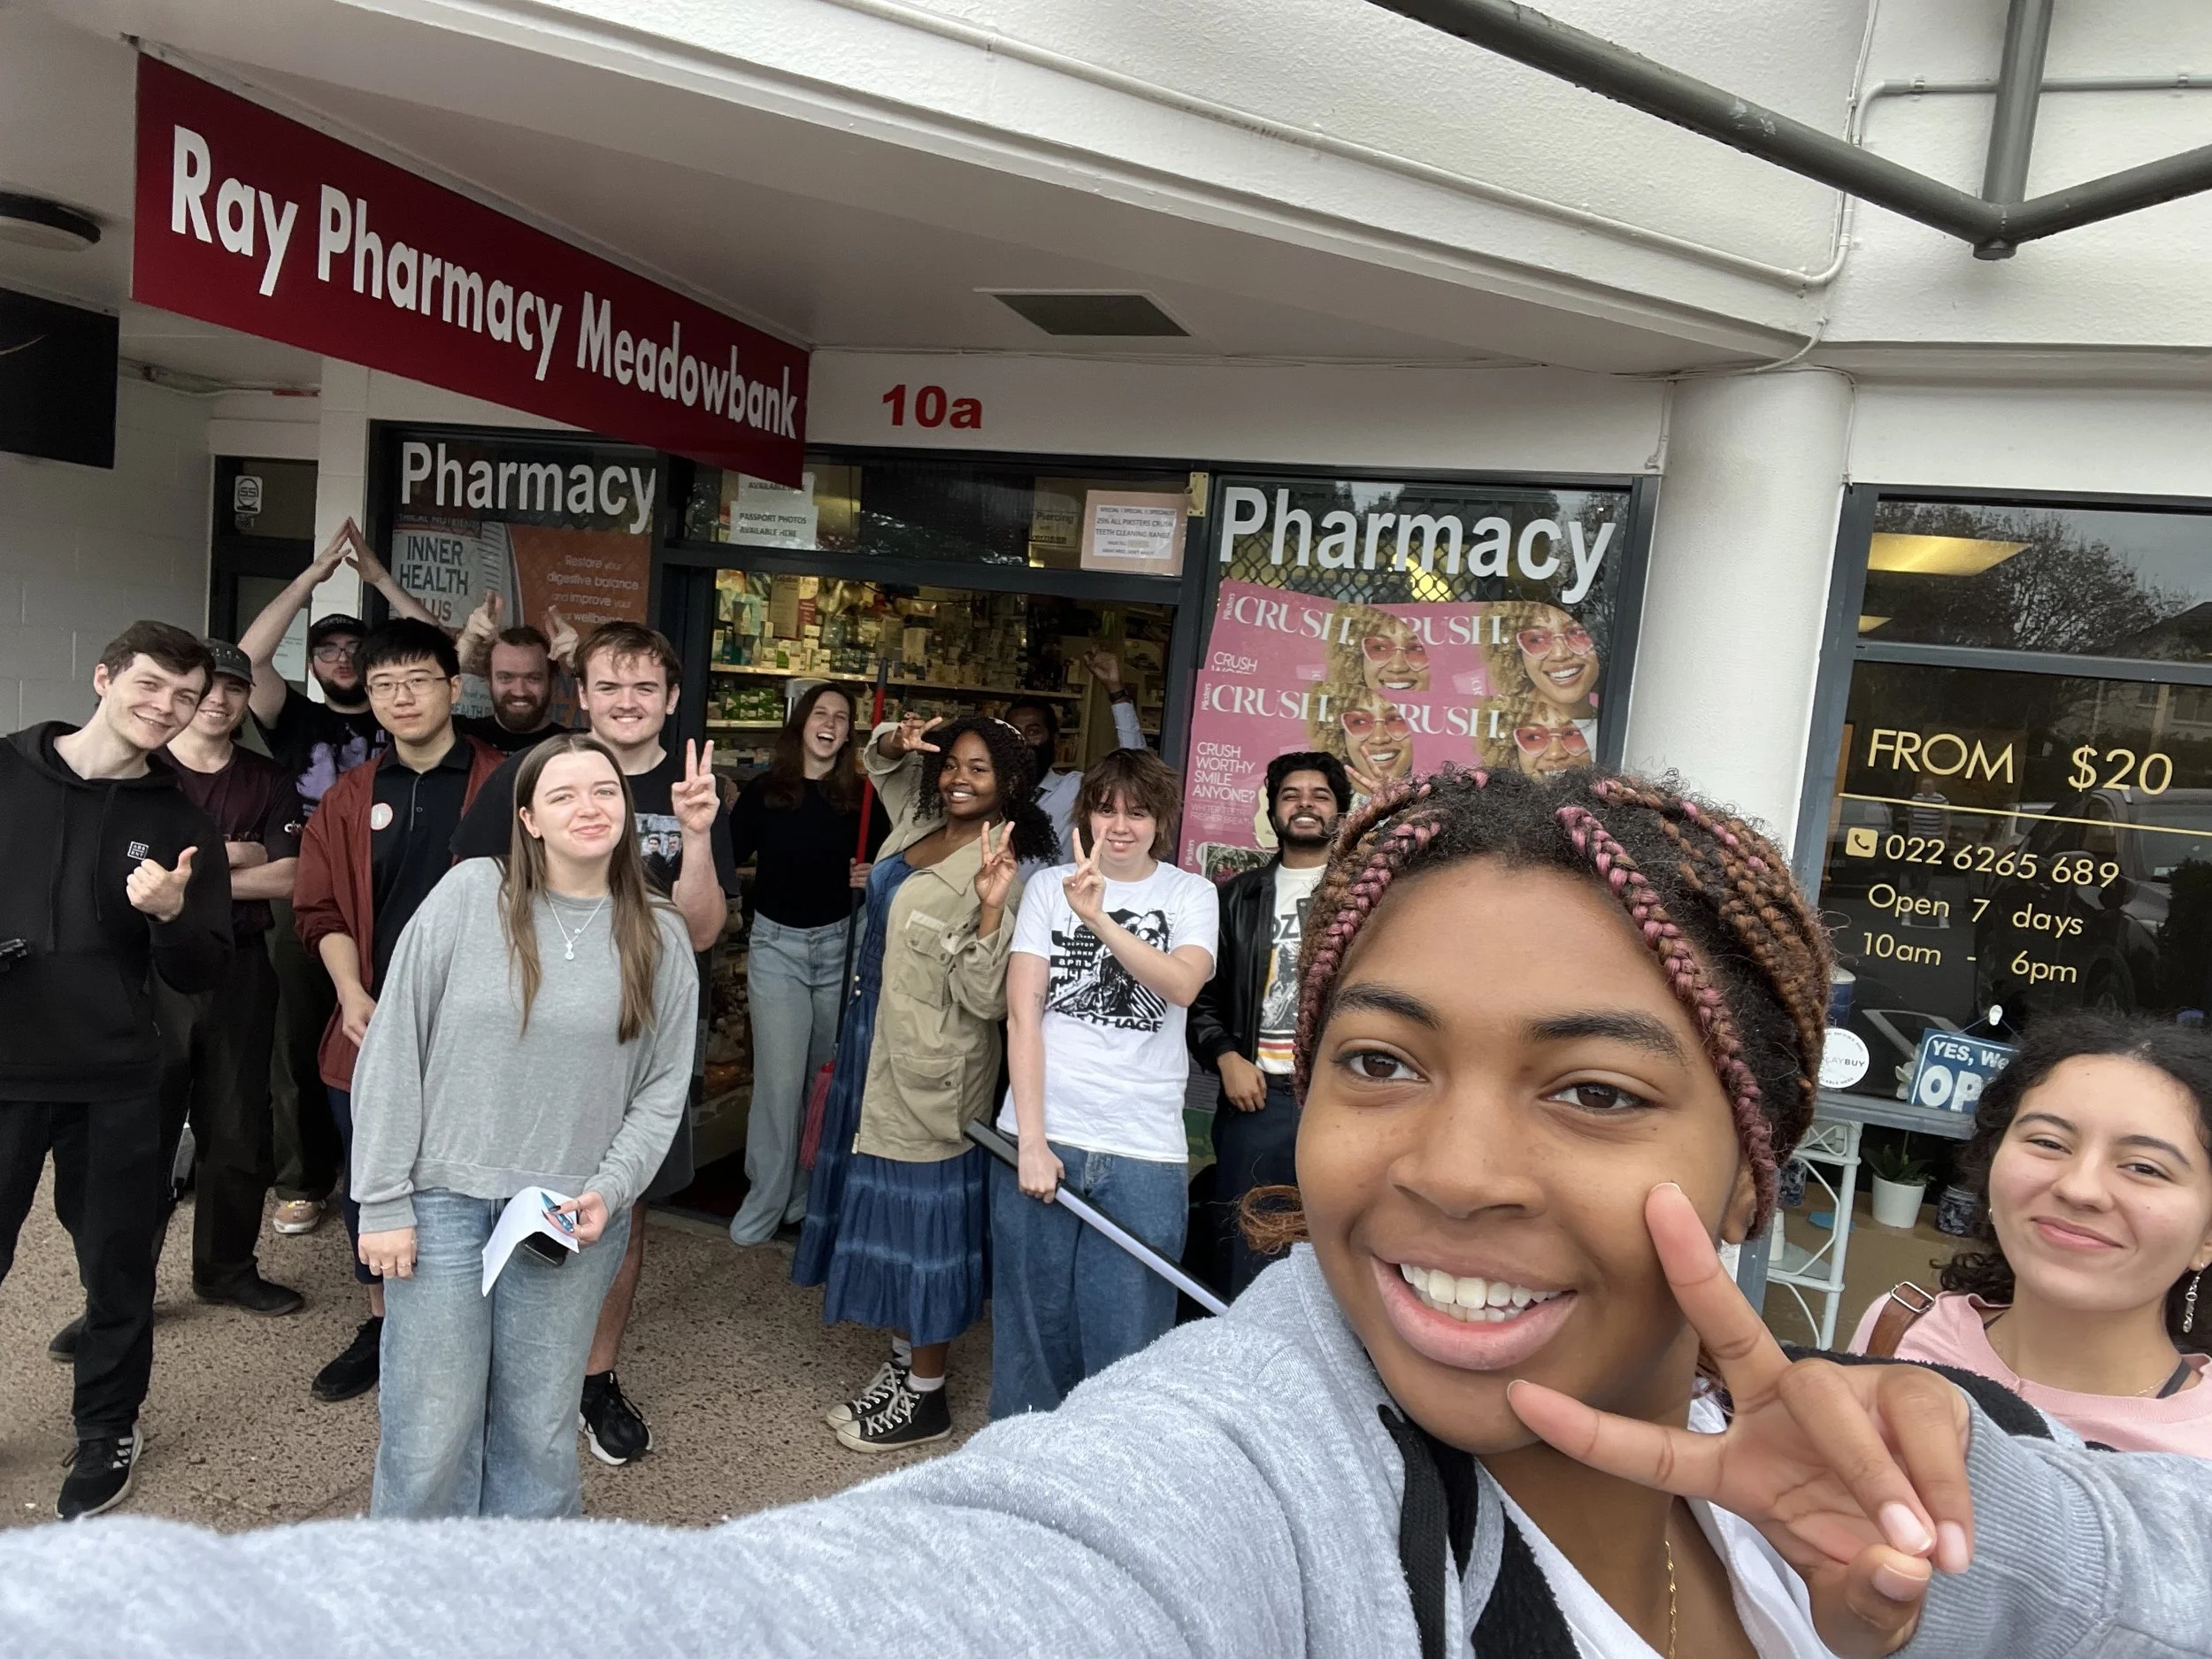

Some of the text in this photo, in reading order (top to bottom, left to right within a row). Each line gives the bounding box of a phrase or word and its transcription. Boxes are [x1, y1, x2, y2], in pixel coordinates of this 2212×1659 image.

[171, 124, 798, 442] Ray Pharmacy Meadowbank
[883, 384, 983, 429] 10a
[401, 442, 657, 534] Pharmacy
[740, 513, 807, 525] PASSPORT PHOTOS
[740, 526, 779, 536] AVAILABLE
[407, 535, 464, 566] INNER
[565, 554, 603, 569] Restore
[1219, 486, 1616, 604] Pharmacy
[399, 563, 469, 596] HEALTH
[547, 571, 639, 590] digestive balance
[570, 592, 611, 607] improve
[1234, 595, 1355, 646] CRUSH.
[1213, 651, 1258, 672] CRUSH
[1211, 684, 1334, 723] CRUSH.
[1393, 703, 1506, 740] RUSH.
[1195, 756, 1256, 774] WORTHY
[1197, 741, 1241, 758] CRUSH
[1867, 728, 2174, 795] FROM $20
[1192, 784, 1256, 803] ANYONE?
[1194, 770, 1233, 787] SMILE
[1886, 834, 2121, 888] 022 6265 689
[1868, 884, 2084, 939] Open 7 days
[1863, 932, 1942, 966] 10am
[2010, 950, 2078, 984] 6pm
[1933, 1040, 1974, 1067] YES,
[1919, 1064, 1983, 1113] OP
